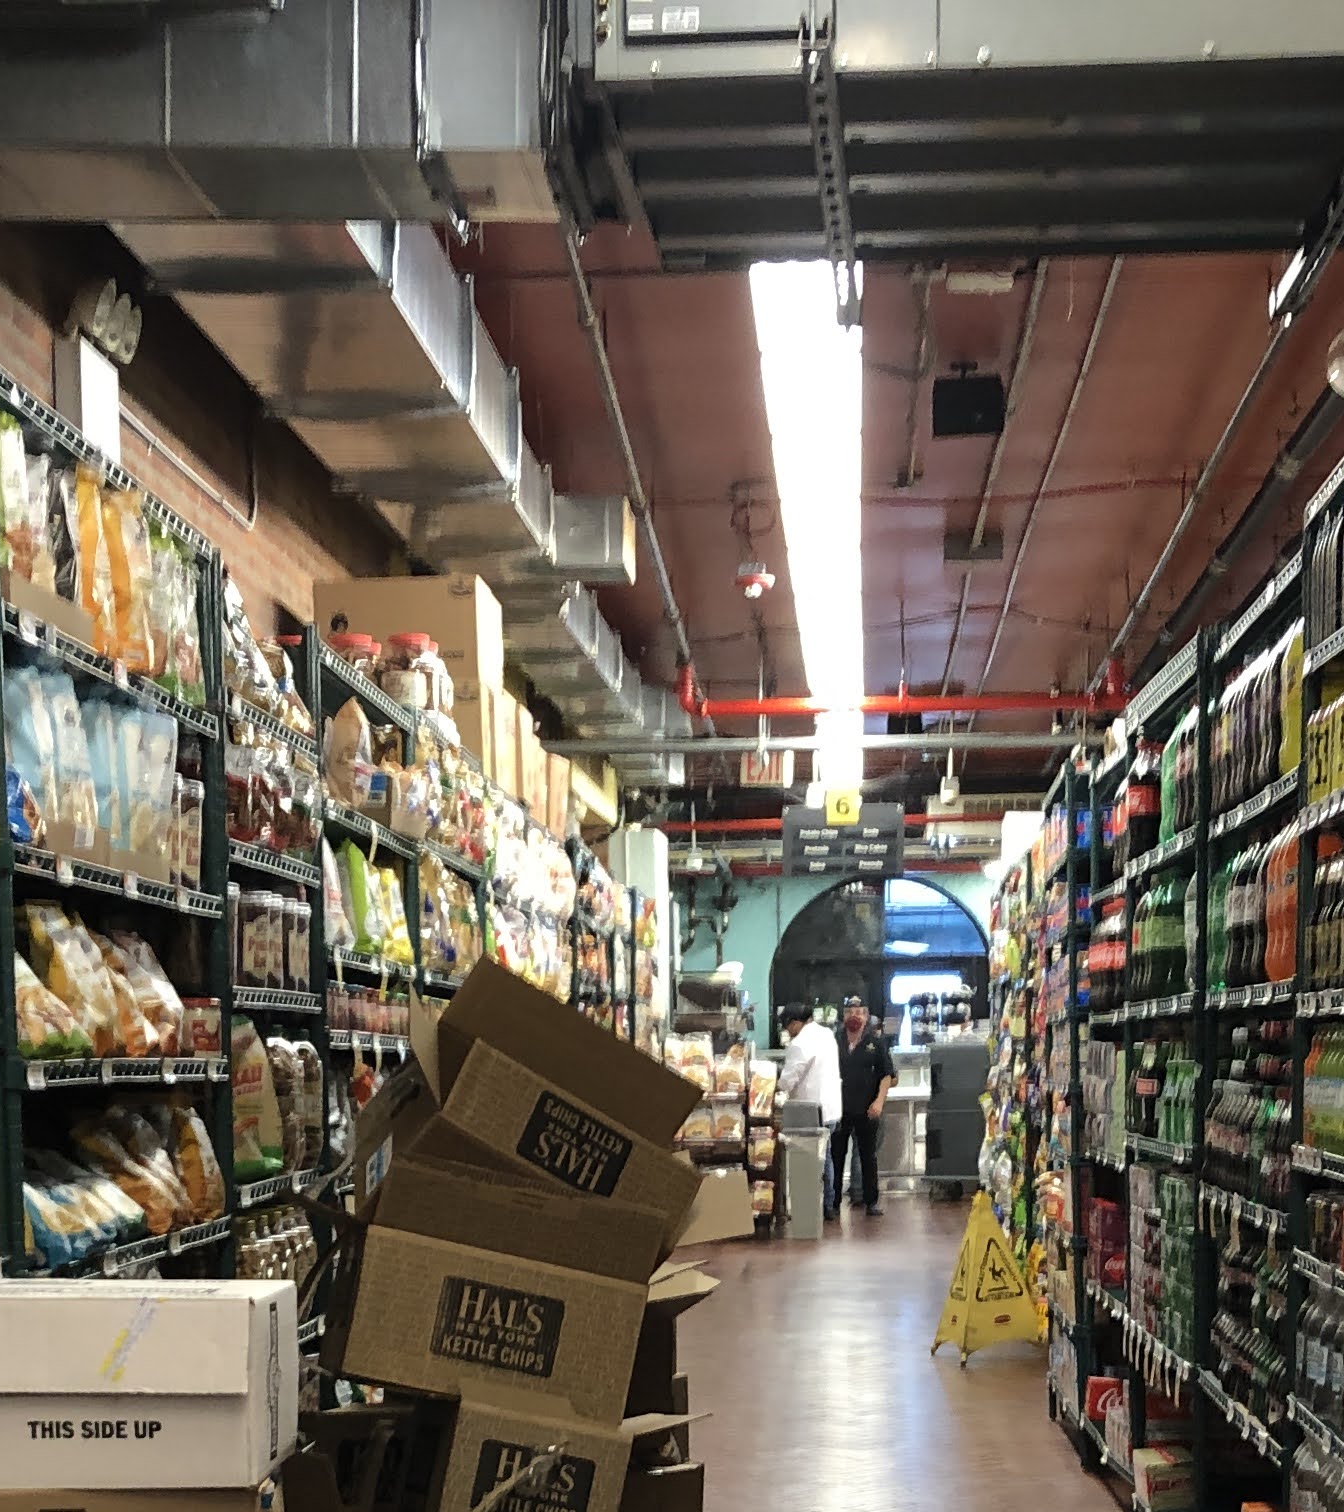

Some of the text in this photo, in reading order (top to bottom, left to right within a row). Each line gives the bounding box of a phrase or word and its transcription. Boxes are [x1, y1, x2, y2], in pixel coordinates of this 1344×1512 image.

[836, 797, 850, 816] 6
[458, 1285, 544, 1334] HAL'S
[441, 1333, 545, 1371] KETTLE CHIPS
[27, 1420, 162, 1439] THIS SIDE UP
